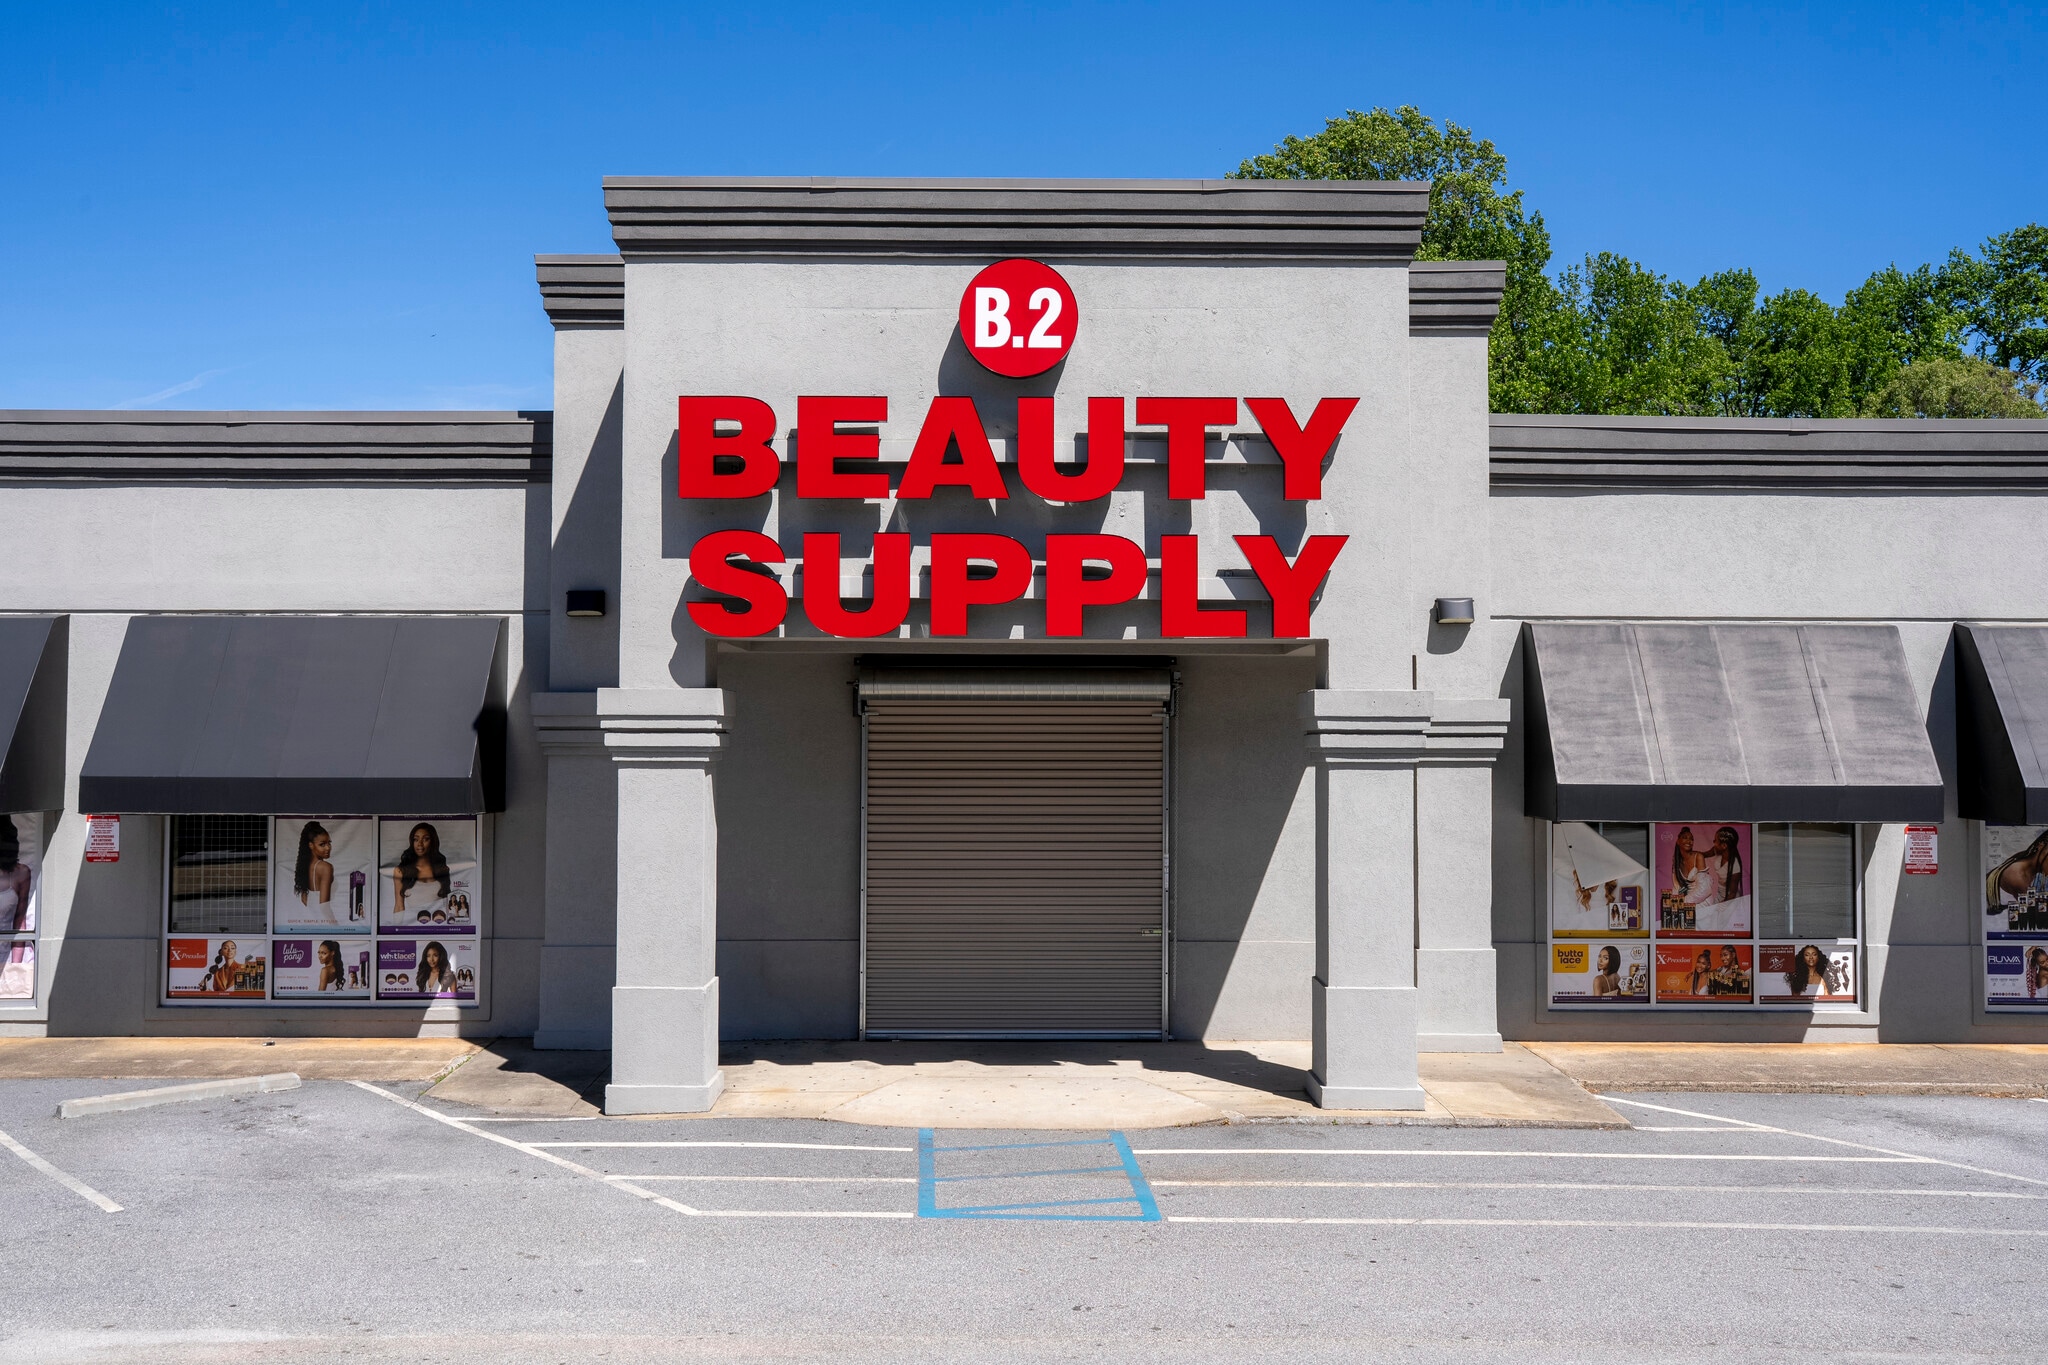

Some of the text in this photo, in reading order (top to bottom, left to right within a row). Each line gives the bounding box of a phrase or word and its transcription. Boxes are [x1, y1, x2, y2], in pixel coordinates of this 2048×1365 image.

[974, 287, 1062, 349] B.2
[678, 395, 1361, 502] BEAUTY
[686, 529, 1350, 638] SUPPLY
[1557, 949, 1583, 957] butta
[1560, 956, 1582, 964] lace
